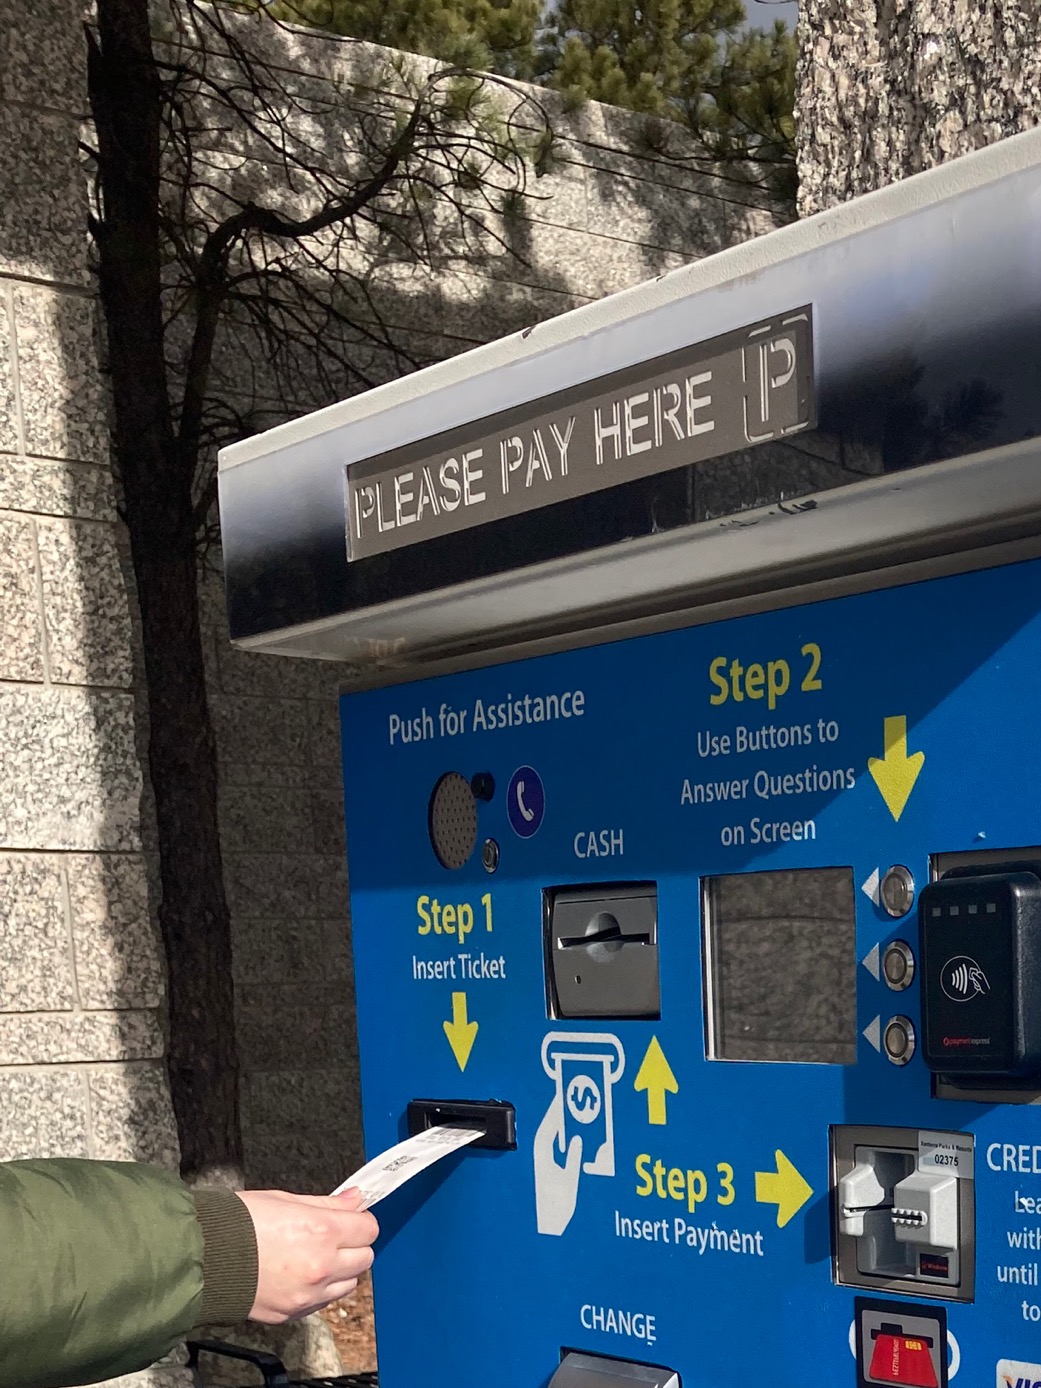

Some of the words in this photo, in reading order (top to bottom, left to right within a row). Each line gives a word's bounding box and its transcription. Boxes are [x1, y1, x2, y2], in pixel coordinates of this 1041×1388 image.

[354, 449, 486, 539] PLEASE
[501, 416, 576, 494] PAY
[594, 371, 715, 465] HERE
[709, 655, 790, 710] Step
[801, 642, 823, 692] 2
[389, 707, 434, 745] Push
[438, 703, 467, 737] for
[473, 690, 585, 732] Assistance
[697, 730, 730, 758] Use
[736, 722, 812, 753] Buttons
[817, 717, 839, 743] to
[681, 774, 748, 805] Answer
[754, 765, 855, 799] Questions
[574, 829, 624, 860] CASH
[720, 824, 745, 847] on
[750, 817, 816, 845] Screen
[417, 895, 480, 944] Step
[482, 894, 493, 932] 1
[412, 956, 456, 981] Insert
[458, 953, 506, 981] Ticket
[934, 1154, 959, 1167] 02375
[635, 1154, 708, 1213] Step
[716, 1162, 736, 1205] 3
[615, 1210, 669, 1243] Insert
[674, 1218, 764, 1257] Payment
[997, 1263, 1038, 1286] until
[580, 1304, 657, 1341] CHANGE
[1022, 1300, 1041, 1321] to
